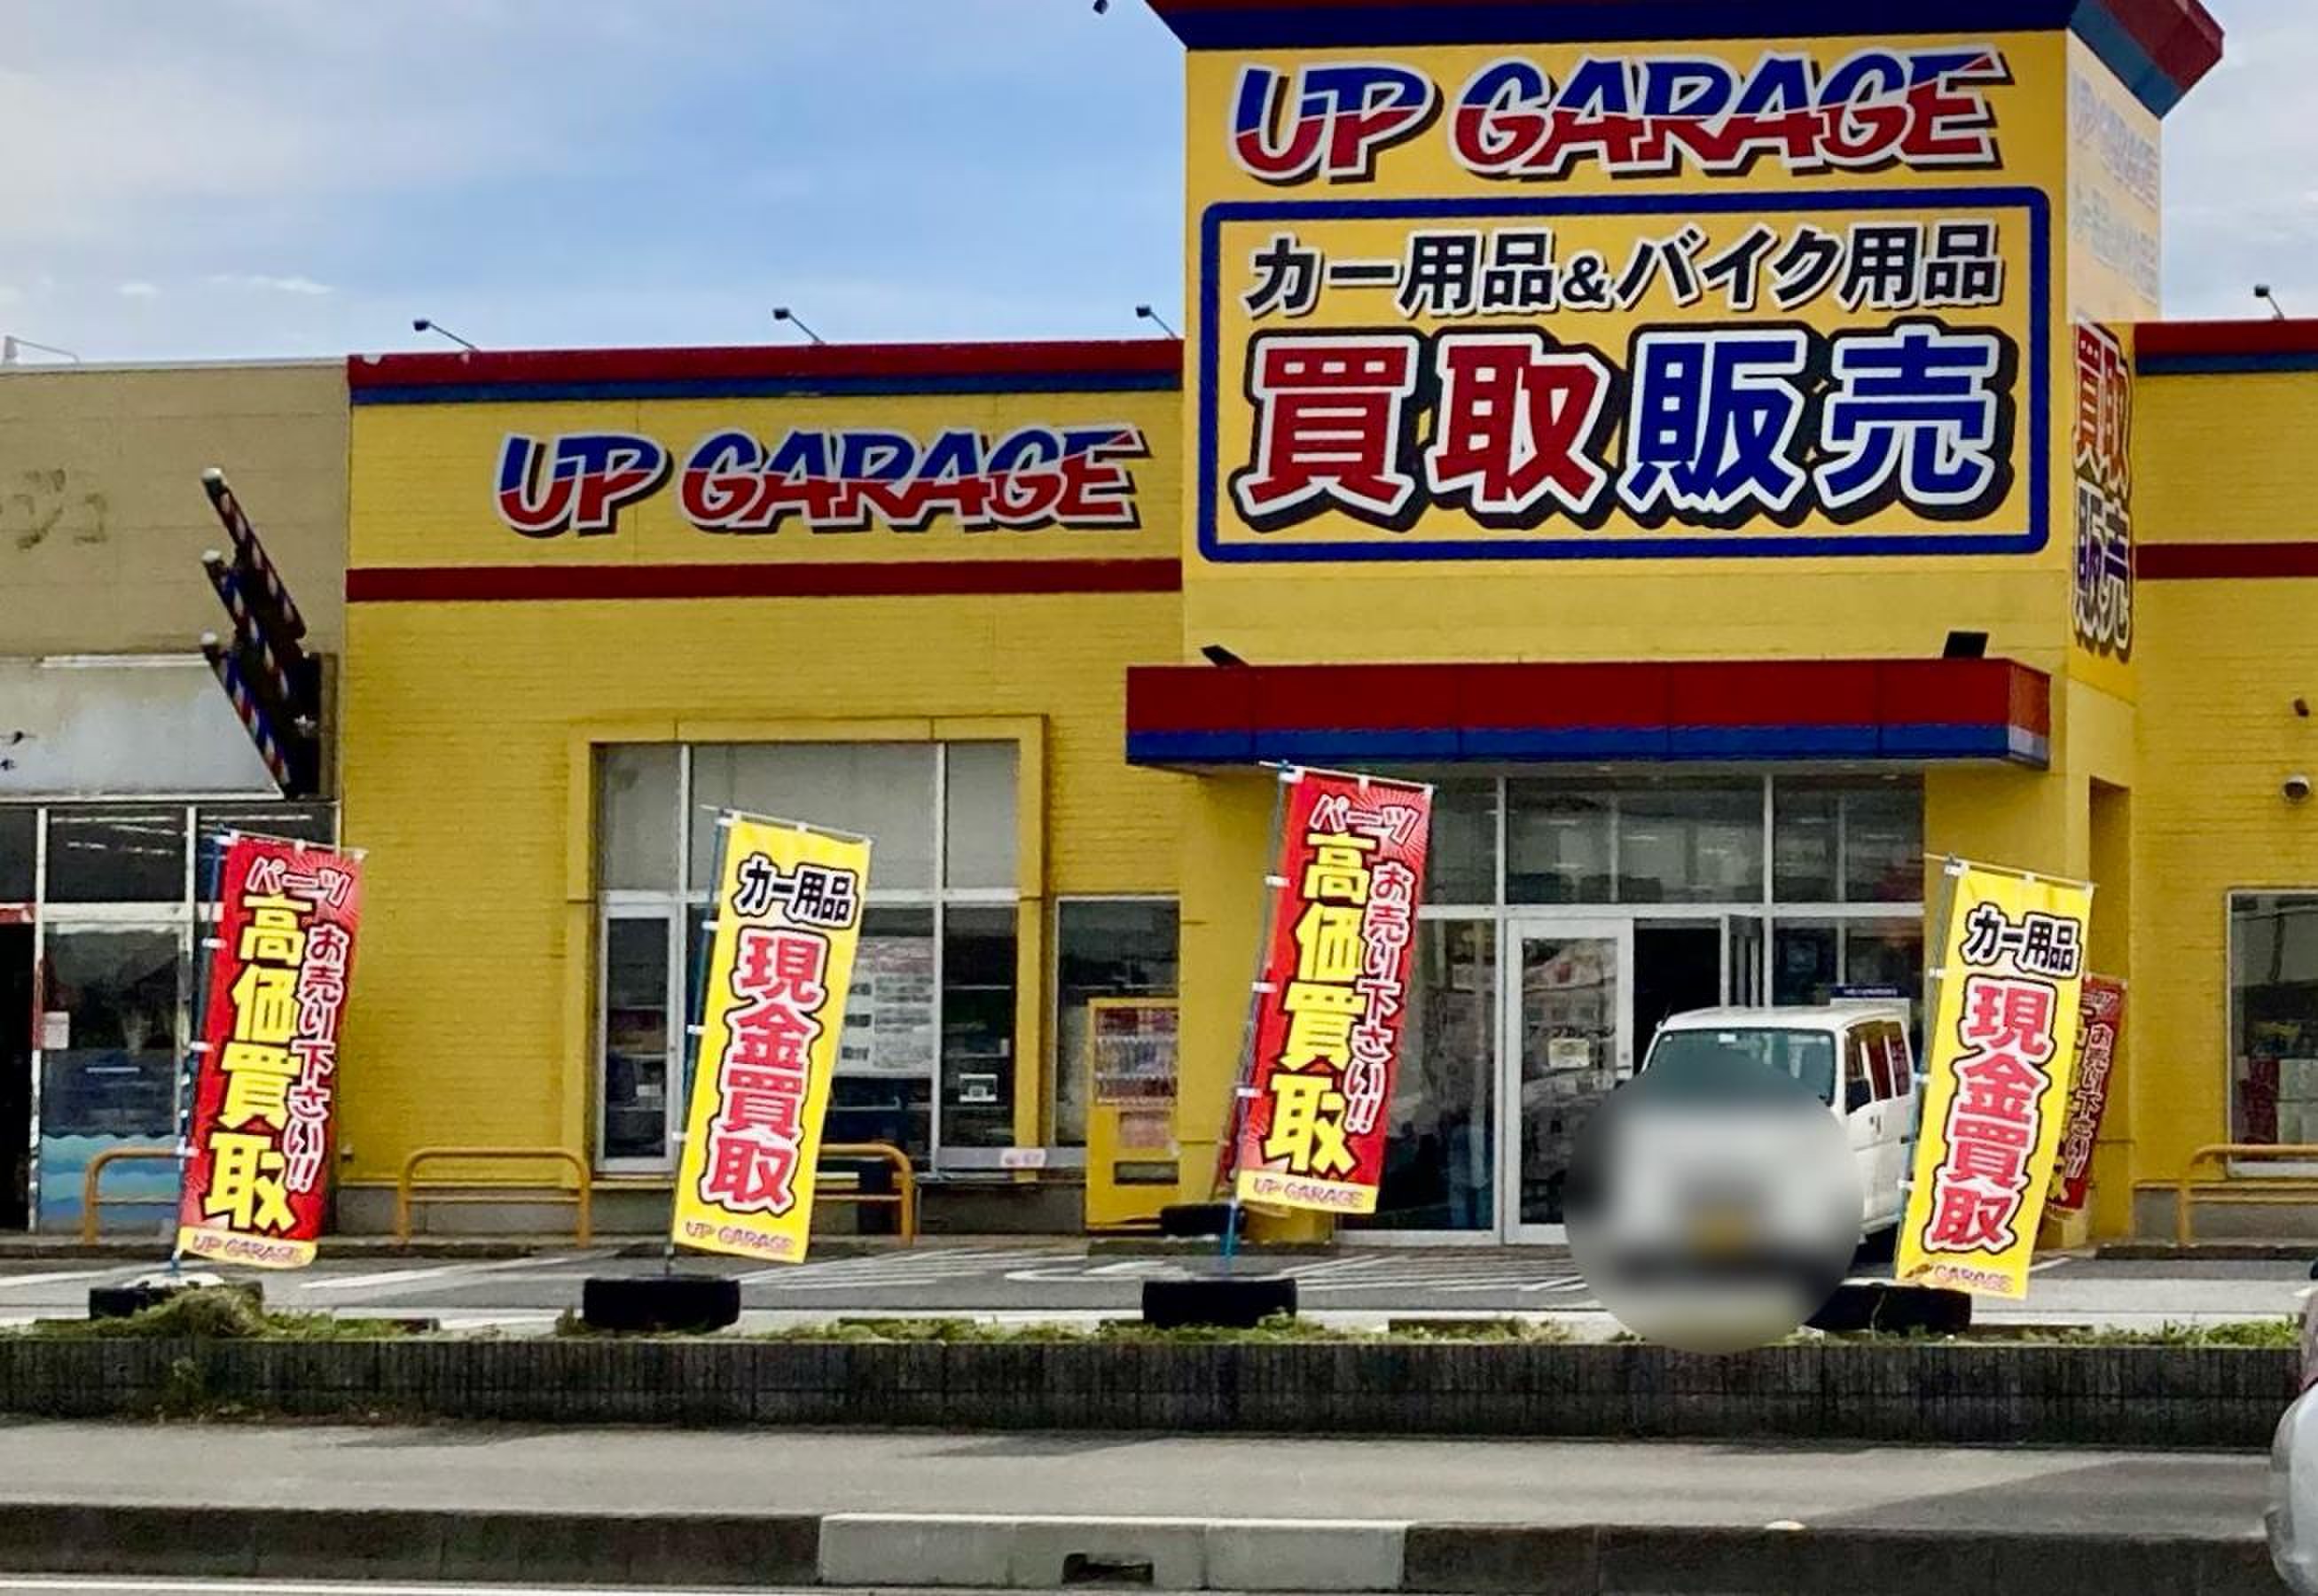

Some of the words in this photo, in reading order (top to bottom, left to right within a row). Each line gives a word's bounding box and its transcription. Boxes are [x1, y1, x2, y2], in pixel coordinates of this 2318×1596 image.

[1230, 64, 1442, 179] UP
[1448, 47, 2013, 176] GARAGE
[497, 430, 670, 535] UP
[679, 424, 1151, 531] GARAGE
[1233, 322, 2008, 525] 買取販売
[246, 857, 352, 908] パーツ
[1309, 794, 1420, 844] パーツ
[733, 851, 858, 929] カー用品
[1960, 902, 2082, 980] カー用品
[202, 895, 313, 1232] 高価買取
[1263, 832, 1378, 1177] 高価買取
[695, 927, 830, 1217] 現金買取
[1923, 975, 2057, 1255] 現金買取
